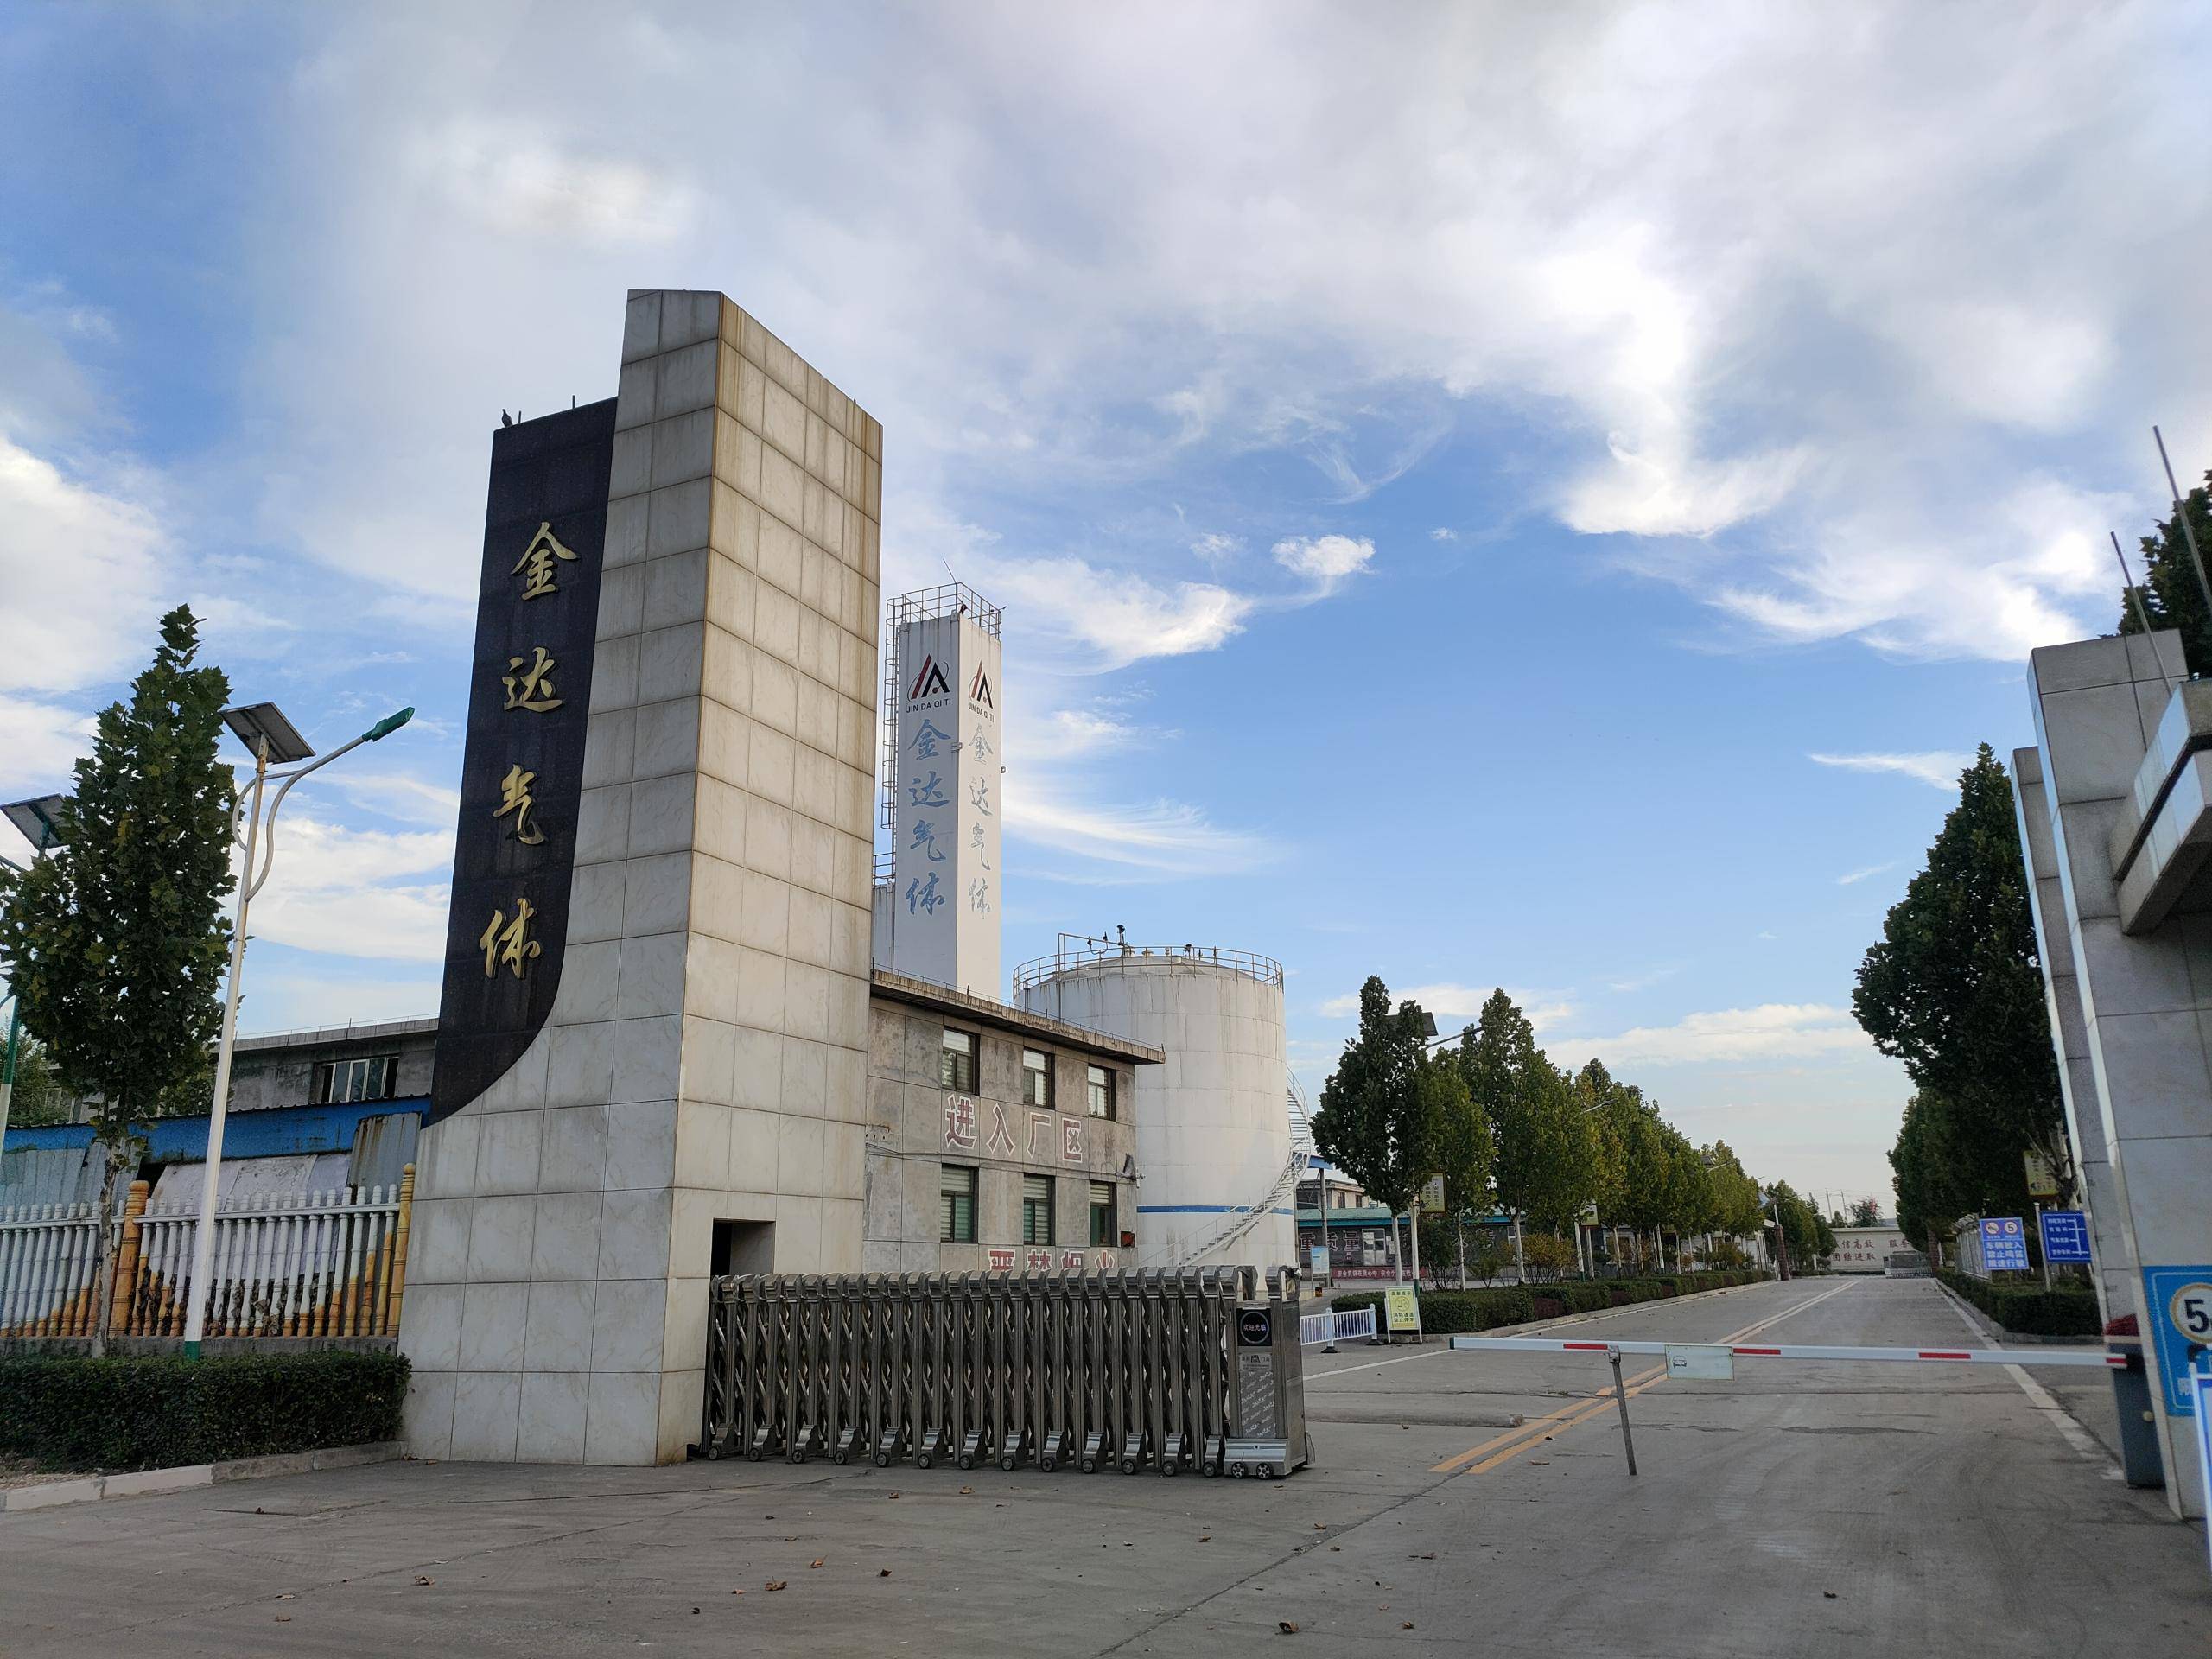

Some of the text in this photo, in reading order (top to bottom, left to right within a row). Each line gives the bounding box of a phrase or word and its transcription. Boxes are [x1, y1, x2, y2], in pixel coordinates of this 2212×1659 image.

[479, 521, 581, 980] 金达气体
[906, 704, 918, 713] JIN
[921, 702, 931, 710] DA
[934, 699, 942, 708] QI
[976, 706, 983, 715] DA
[984, 710, 989, 719] QI
[989, 712, 995, 723] TI
[906, 719, 951, 916] 金达气体
[968, 722, 994, 920] 金达气体
[944, 1094, 1083, 1163] 进入厂区
